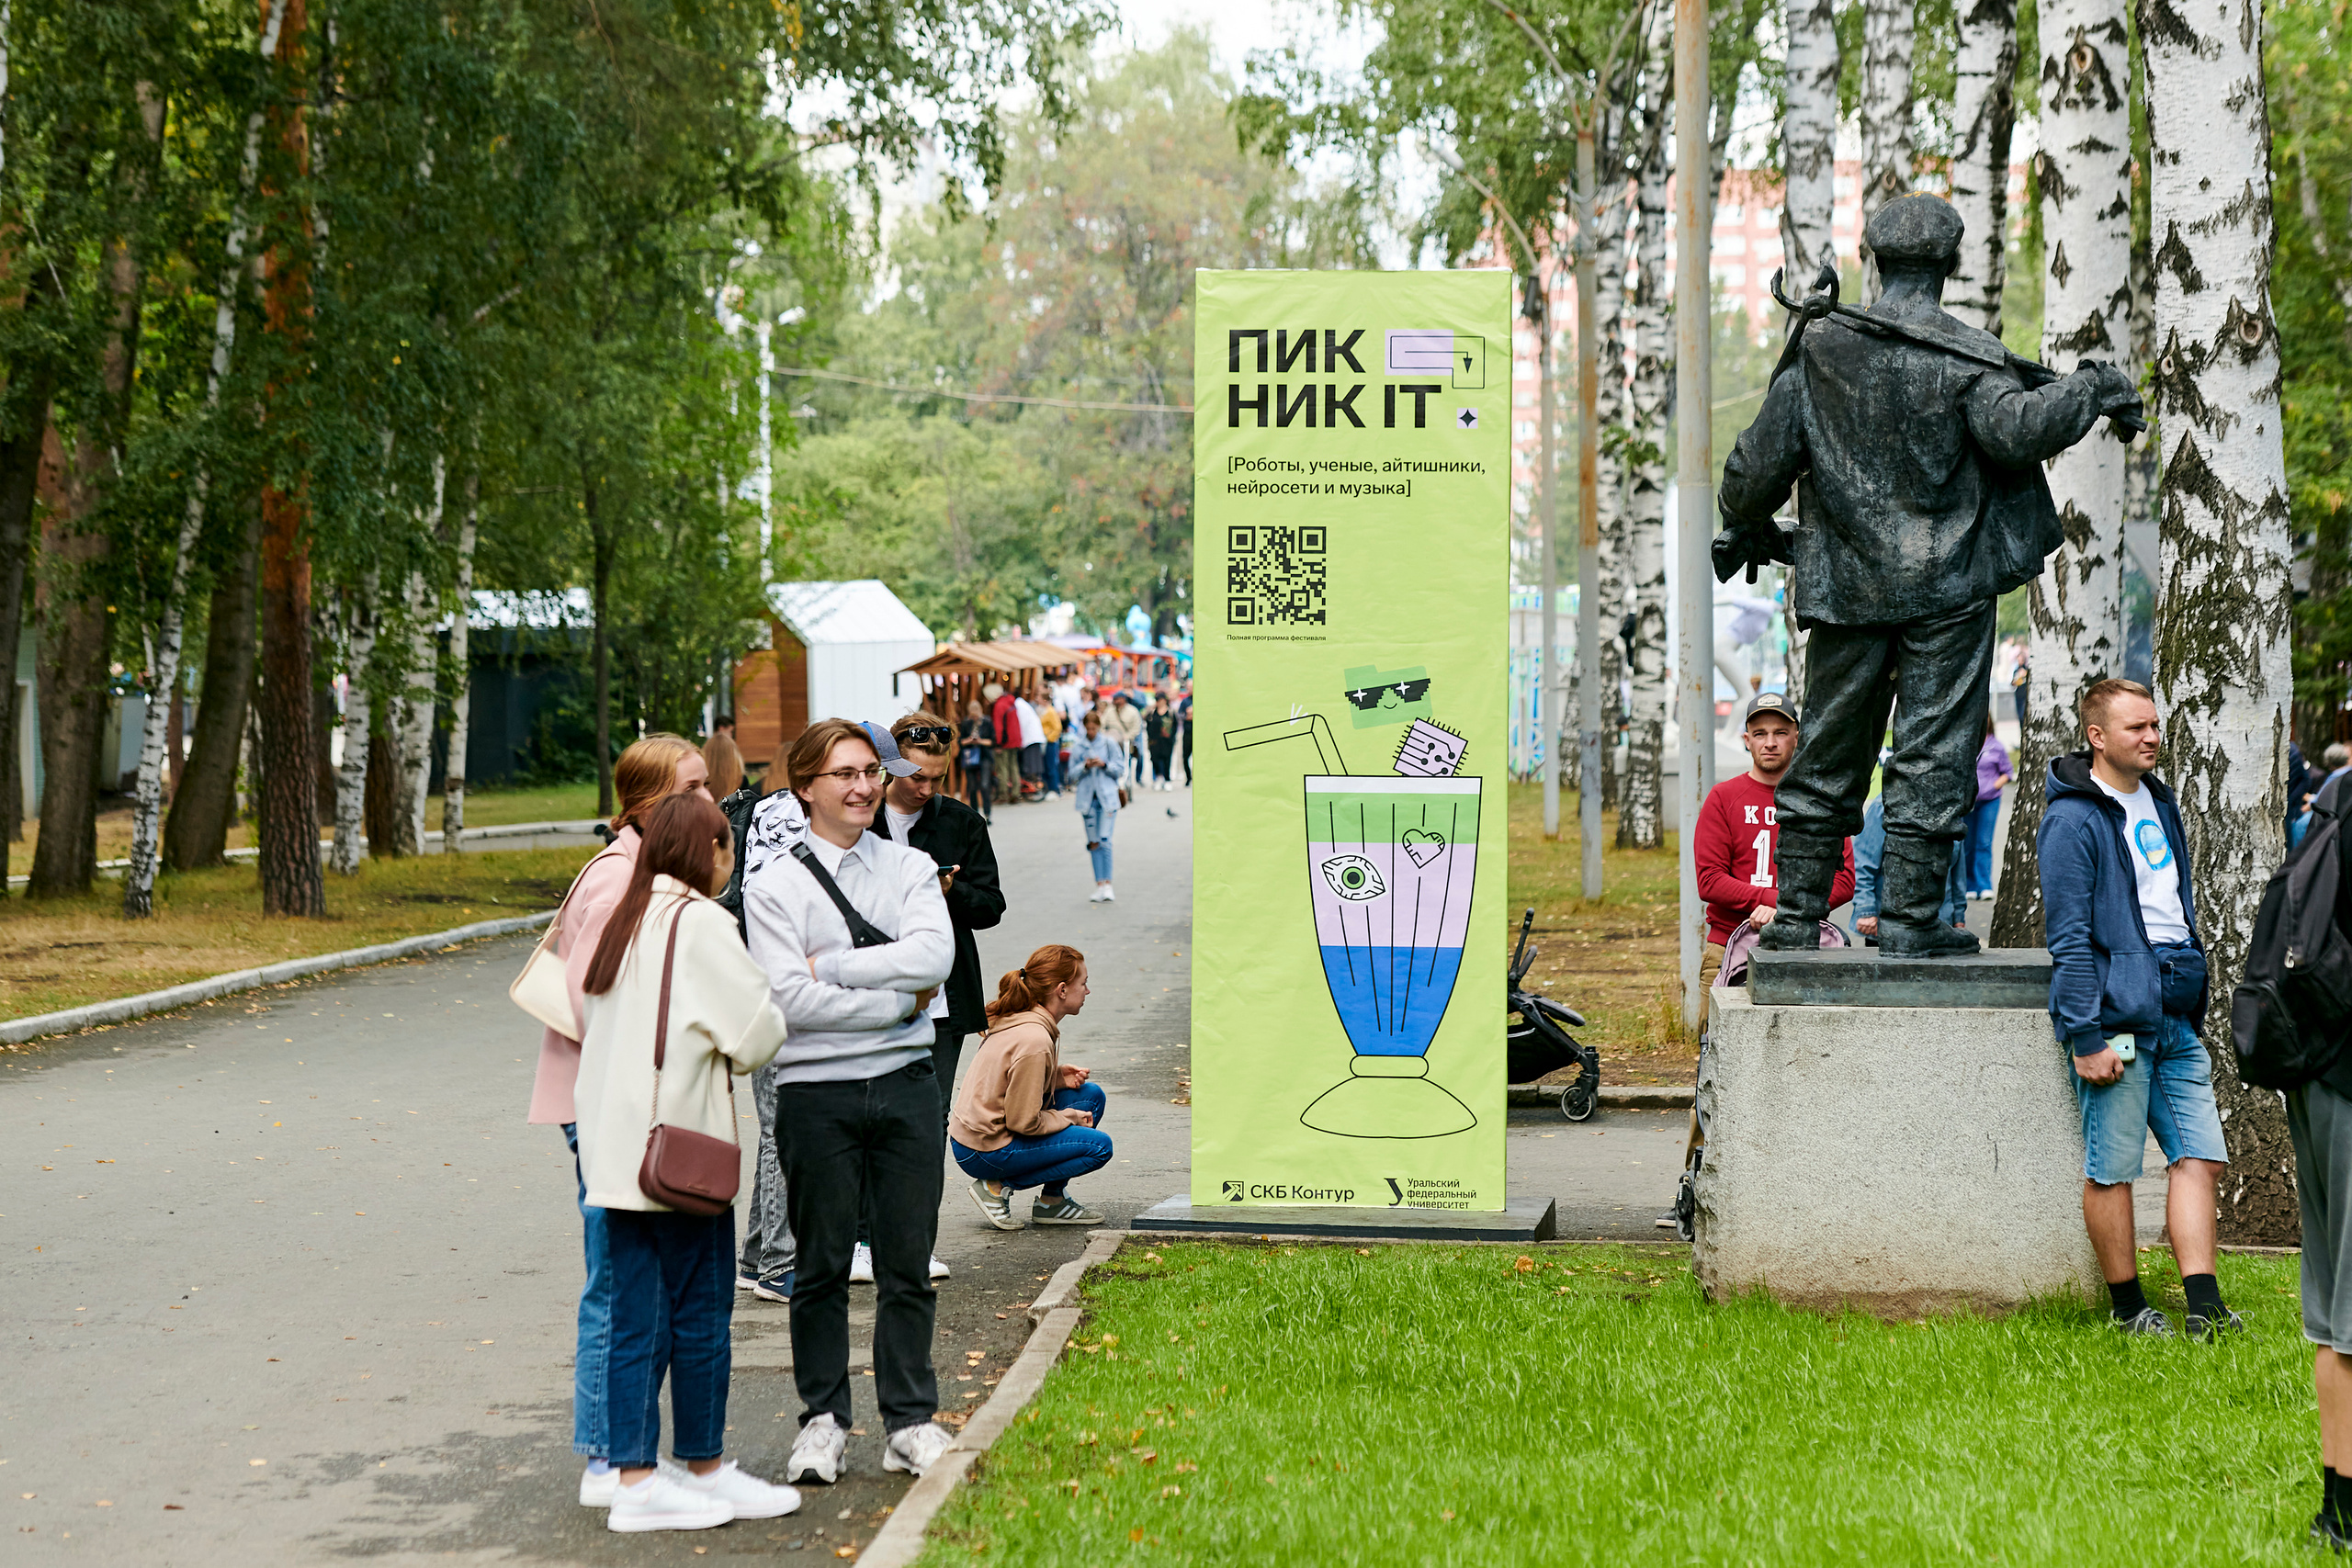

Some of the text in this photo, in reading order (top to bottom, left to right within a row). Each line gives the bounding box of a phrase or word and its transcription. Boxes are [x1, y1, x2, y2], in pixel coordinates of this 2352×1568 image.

[1228, 329, 1366, 373] ПИК
[1228, 384, 1442, 428] НИК IT
[1227, 457, 1486, 475] [Роботы, ученые, айтишники,
[1227, 479, 1411, 498] нейросети и музыка]
[1744, 806, 1777, 826] KO
[1750, 829, 1779, 888] 1
[1250, 1184, 1355, 1202] СКБ Контур
[1408, 1178, 1460, 1189] Уральский
[1407, 1190, 1477, 1200] федеральный
